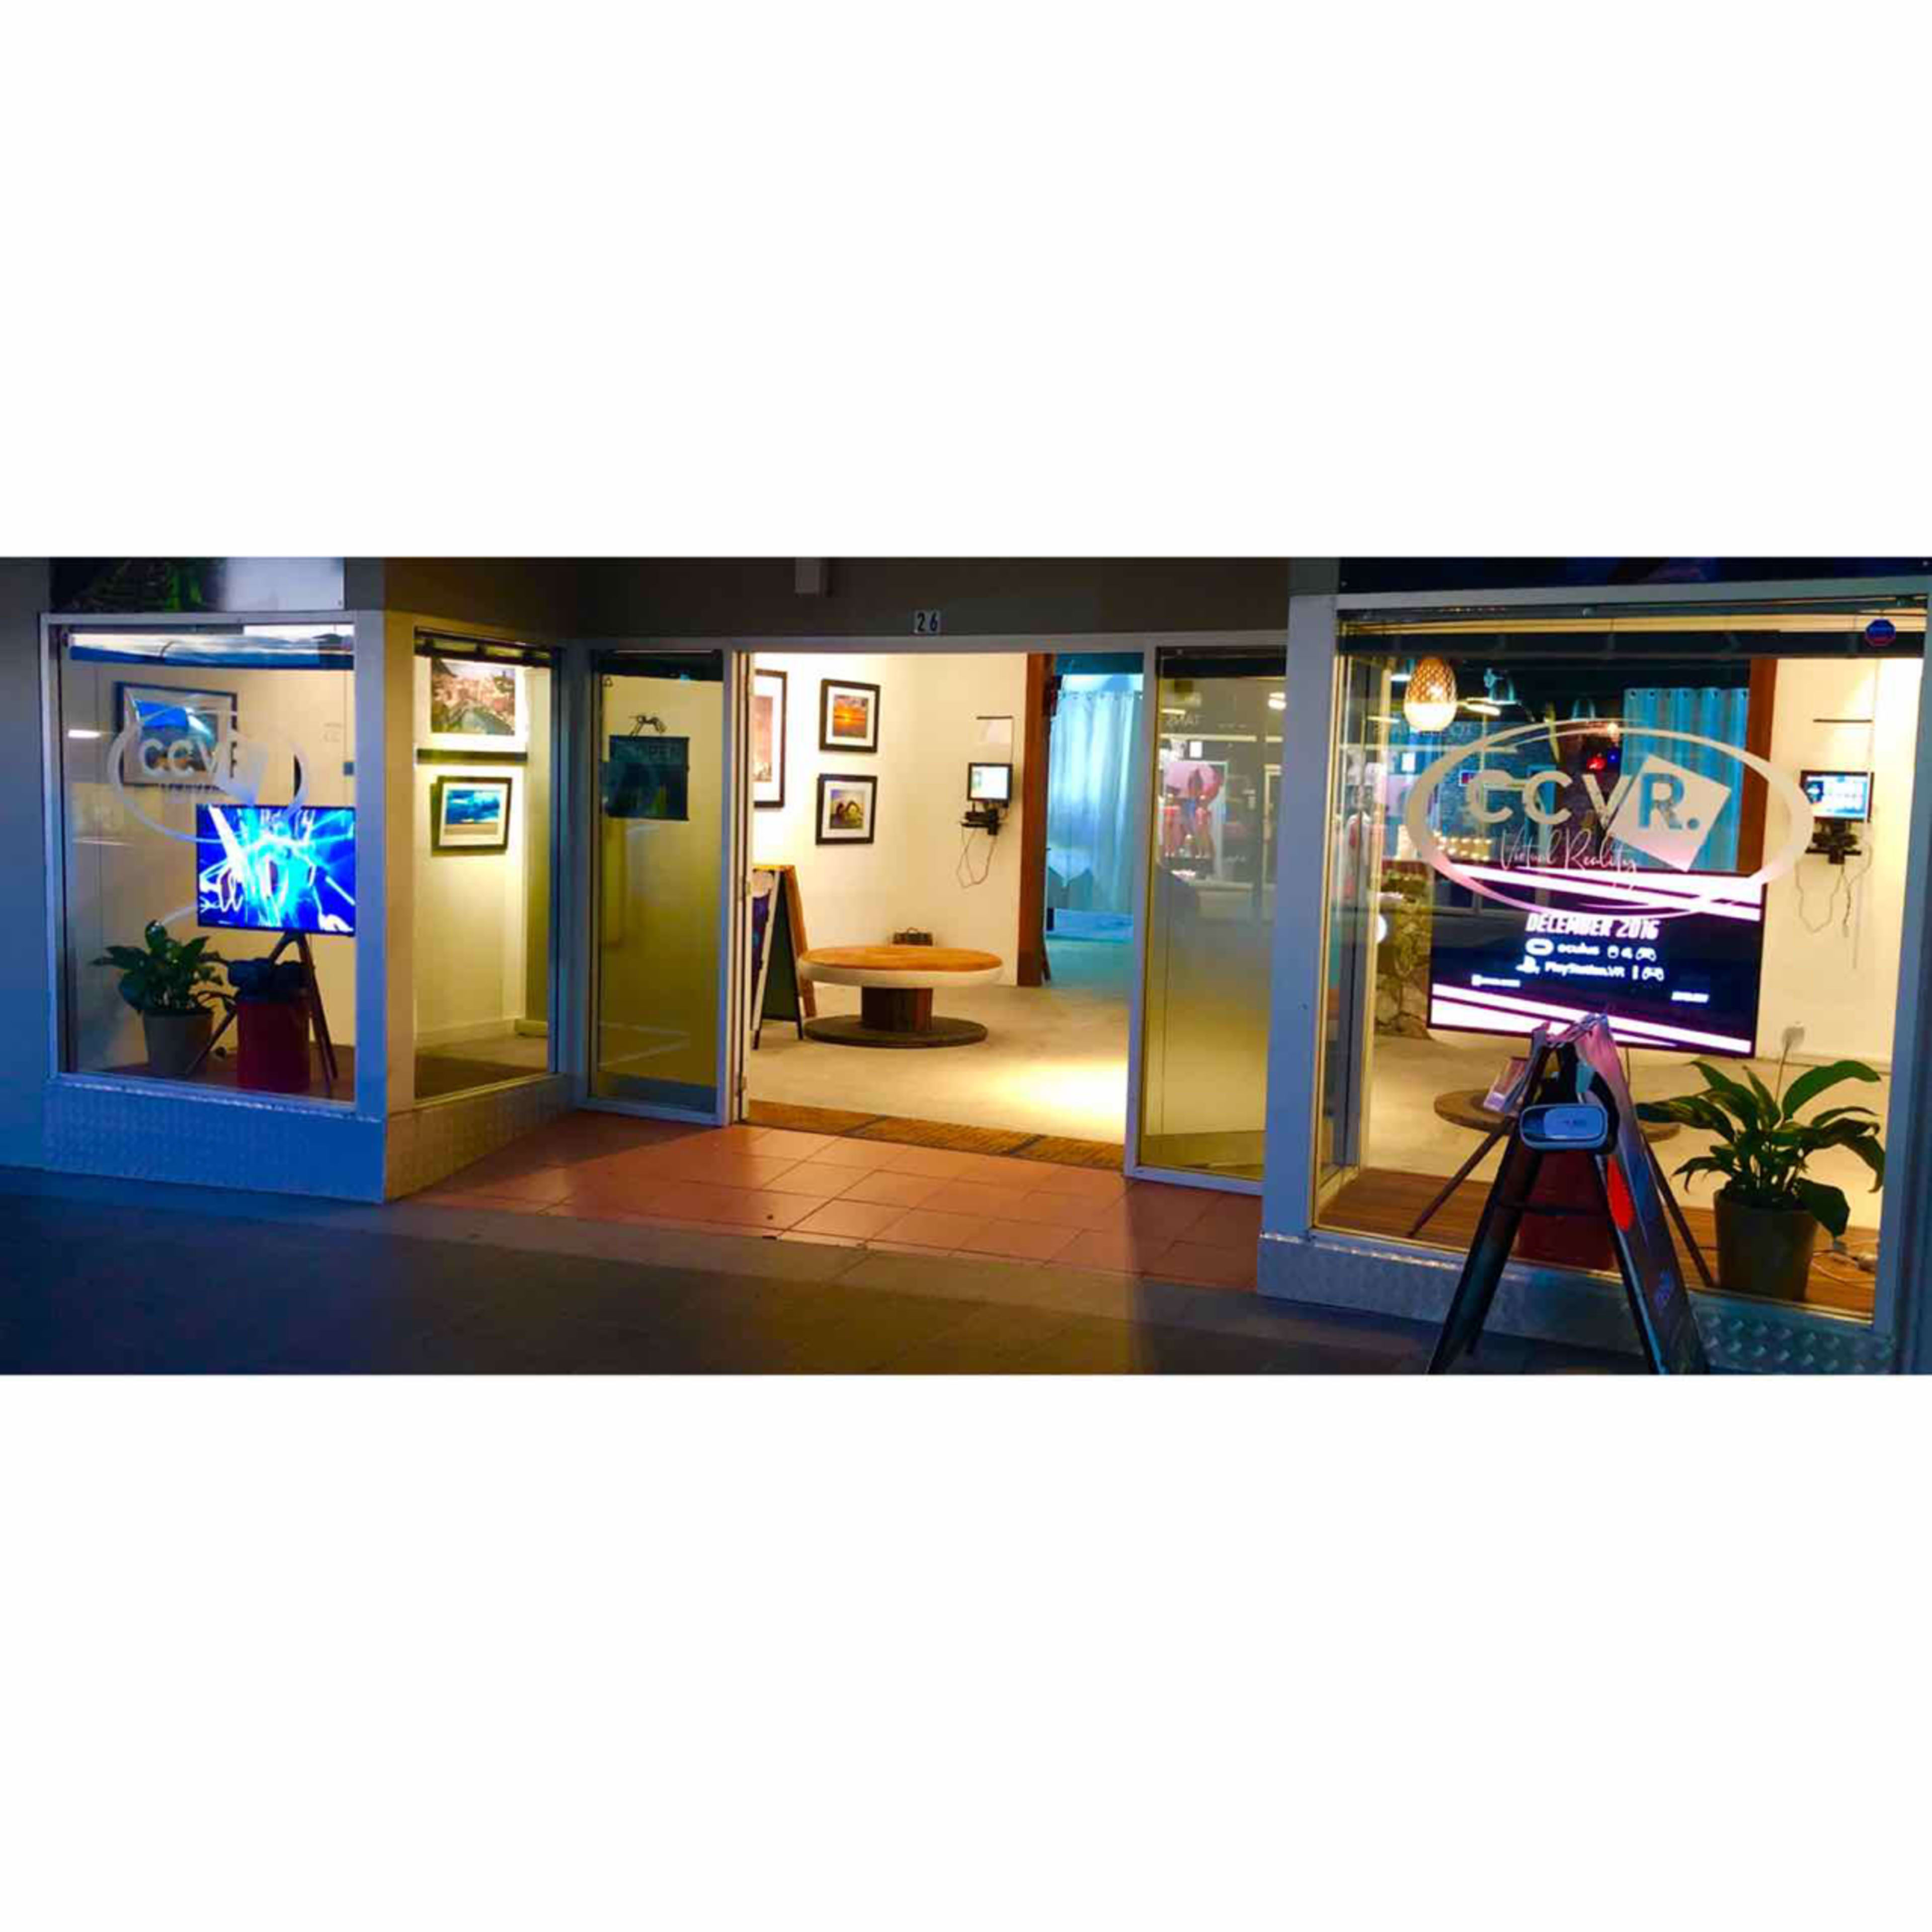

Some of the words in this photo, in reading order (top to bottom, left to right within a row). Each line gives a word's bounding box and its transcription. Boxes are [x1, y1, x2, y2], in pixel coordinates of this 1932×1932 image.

[917, 611, 938, 631] 26
[1563, 824, 1638, 891] Reality
[1525, 912, 1612, 937] DECEMBER
[1615, 919, 1661, 940] 2016
